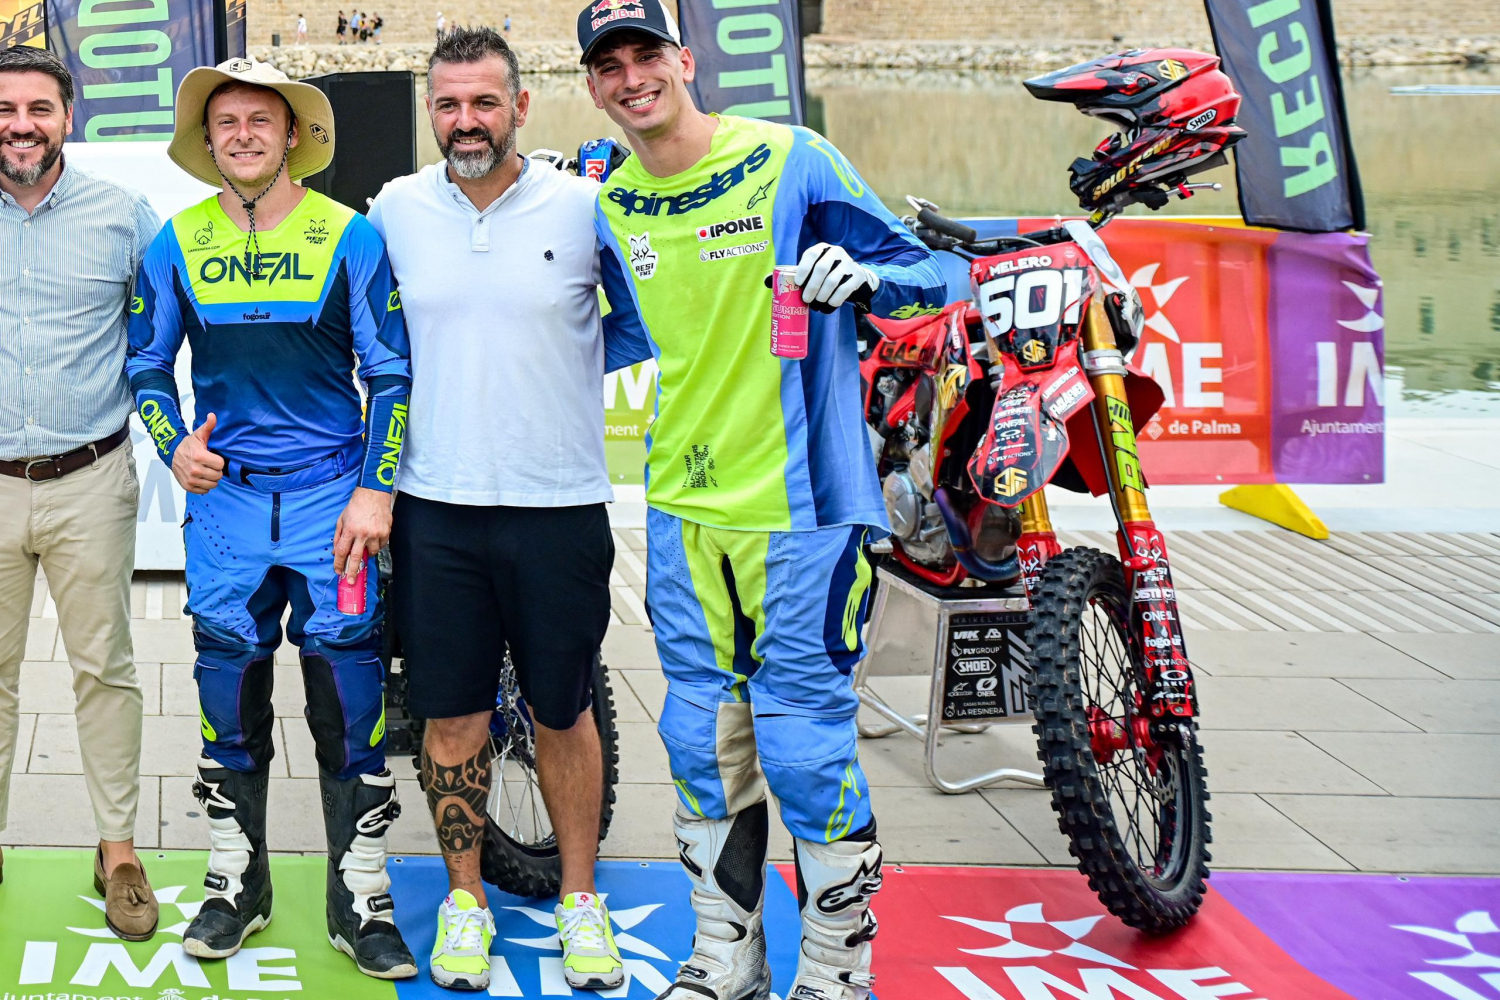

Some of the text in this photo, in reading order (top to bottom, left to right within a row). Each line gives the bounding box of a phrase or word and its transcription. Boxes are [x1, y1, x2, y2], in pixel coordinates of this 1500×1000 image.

[591, 7, 646, 31] Red Bull
[1190, 110, 1215, 130] SHOEI
[608, 143, 771, 217] alpinestars
[1092, 167, 1127, 200] SOLO
[710, 216, 763, 238] IPONE
[635, 263, 654, 272] RESI
[989, 255, 1053, 276] MELERO
[980, 268, 1083, 338] 501
[243, 311, 271, 322] fogosur
[1316, 341, 1384, 407] IM
[1169, 420, 1241, 434] de Palma
[997, 615, 1024, 623] MELE
[1145, 635, 1182, 648] fogour
[959, 660, 991, 673] SHOEI
[957, 707, 1005, 717] LA RESINERA
[19, 940, 302, 991] IME
